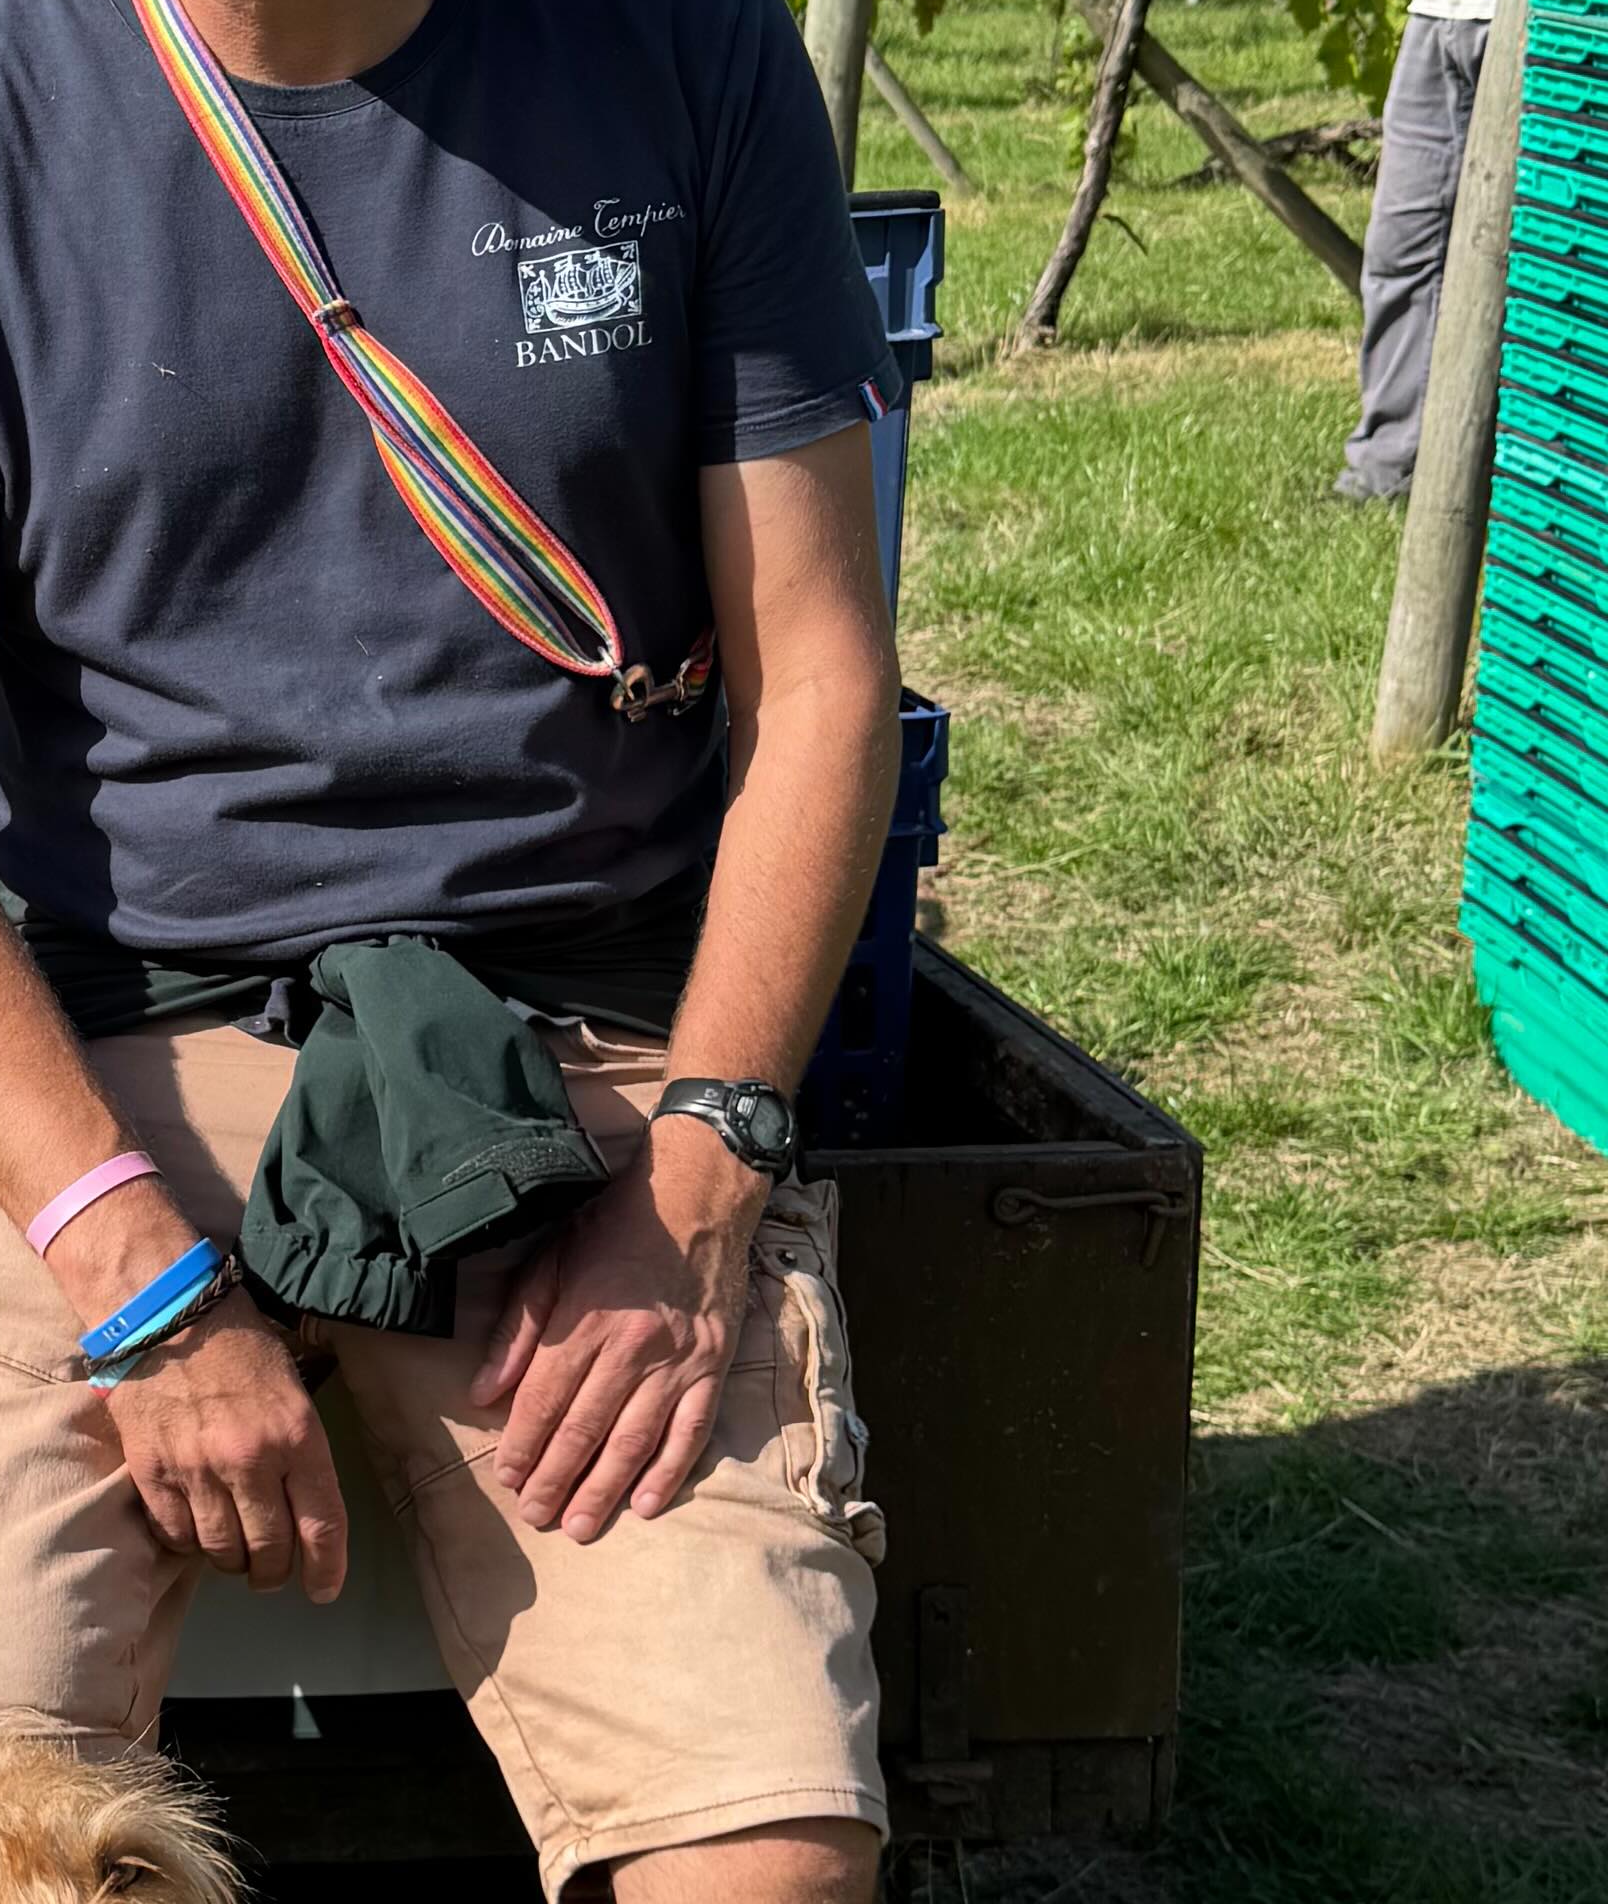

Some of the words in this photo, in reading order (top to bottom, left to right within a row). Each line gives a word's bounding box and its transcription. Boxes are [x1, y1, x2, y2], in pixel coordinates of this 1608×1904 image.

[471, 220, 583, 257] Domaine
[593, 197, 687, 238] Tempier
[515, 320, 653, 368] BANDOL
